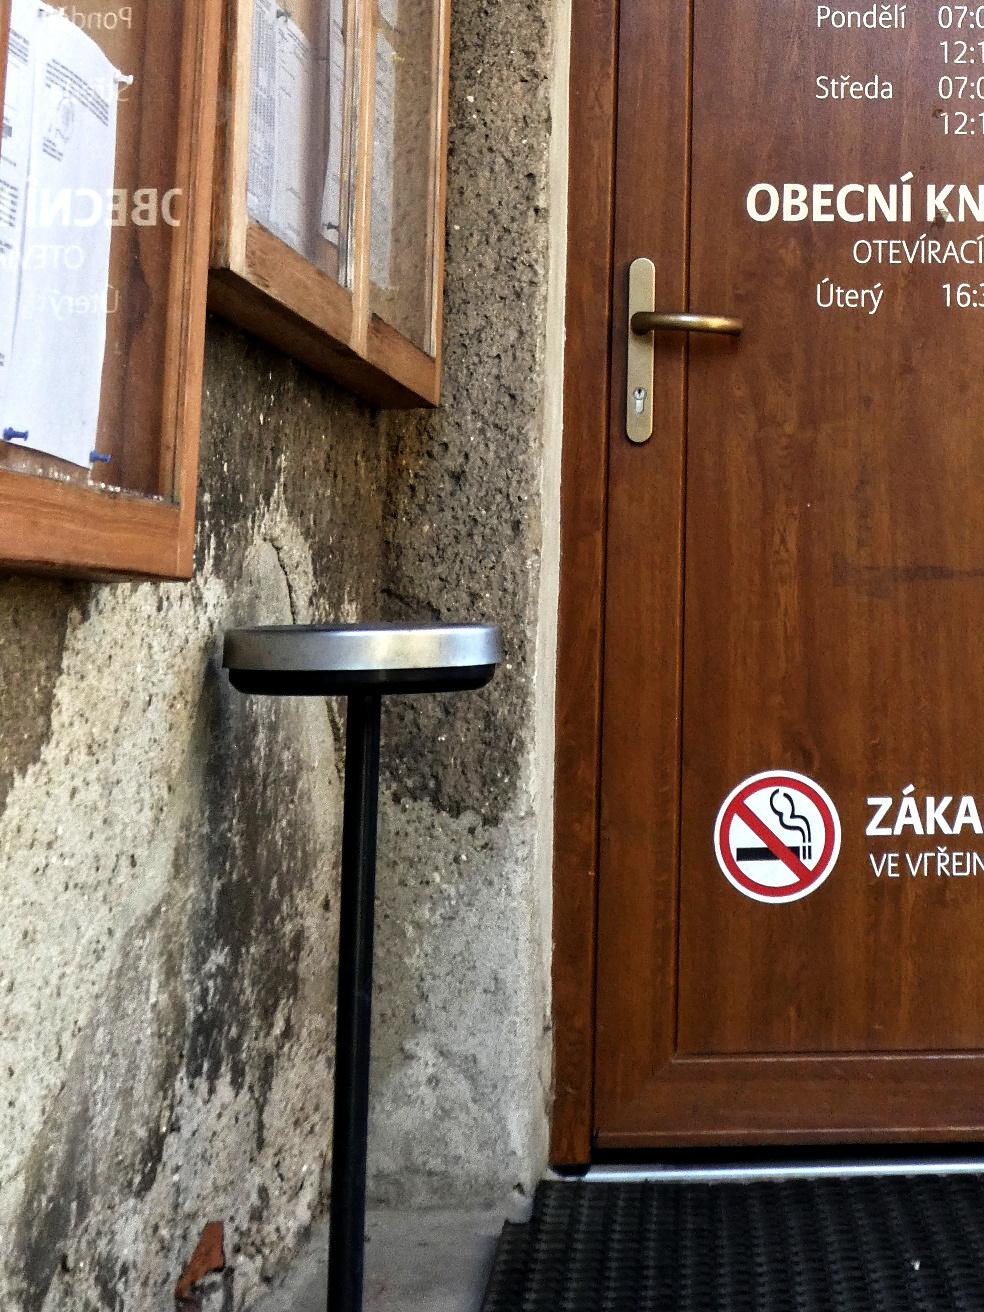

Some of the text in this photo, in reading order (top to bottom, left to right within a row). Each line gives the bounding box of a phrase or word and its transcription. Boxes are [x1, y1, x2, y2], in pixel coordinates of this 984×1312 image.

[816, 2, 907, 29] Pondělí
[815, 74, 893, 100] Středa
[746, 172, 913, 223] OBECNÍ
[853, 233, 984, 265] OTEVÍRACÍ
[816, 277, 884, 315] Úterý
[869, 853, 900, 878] VE
